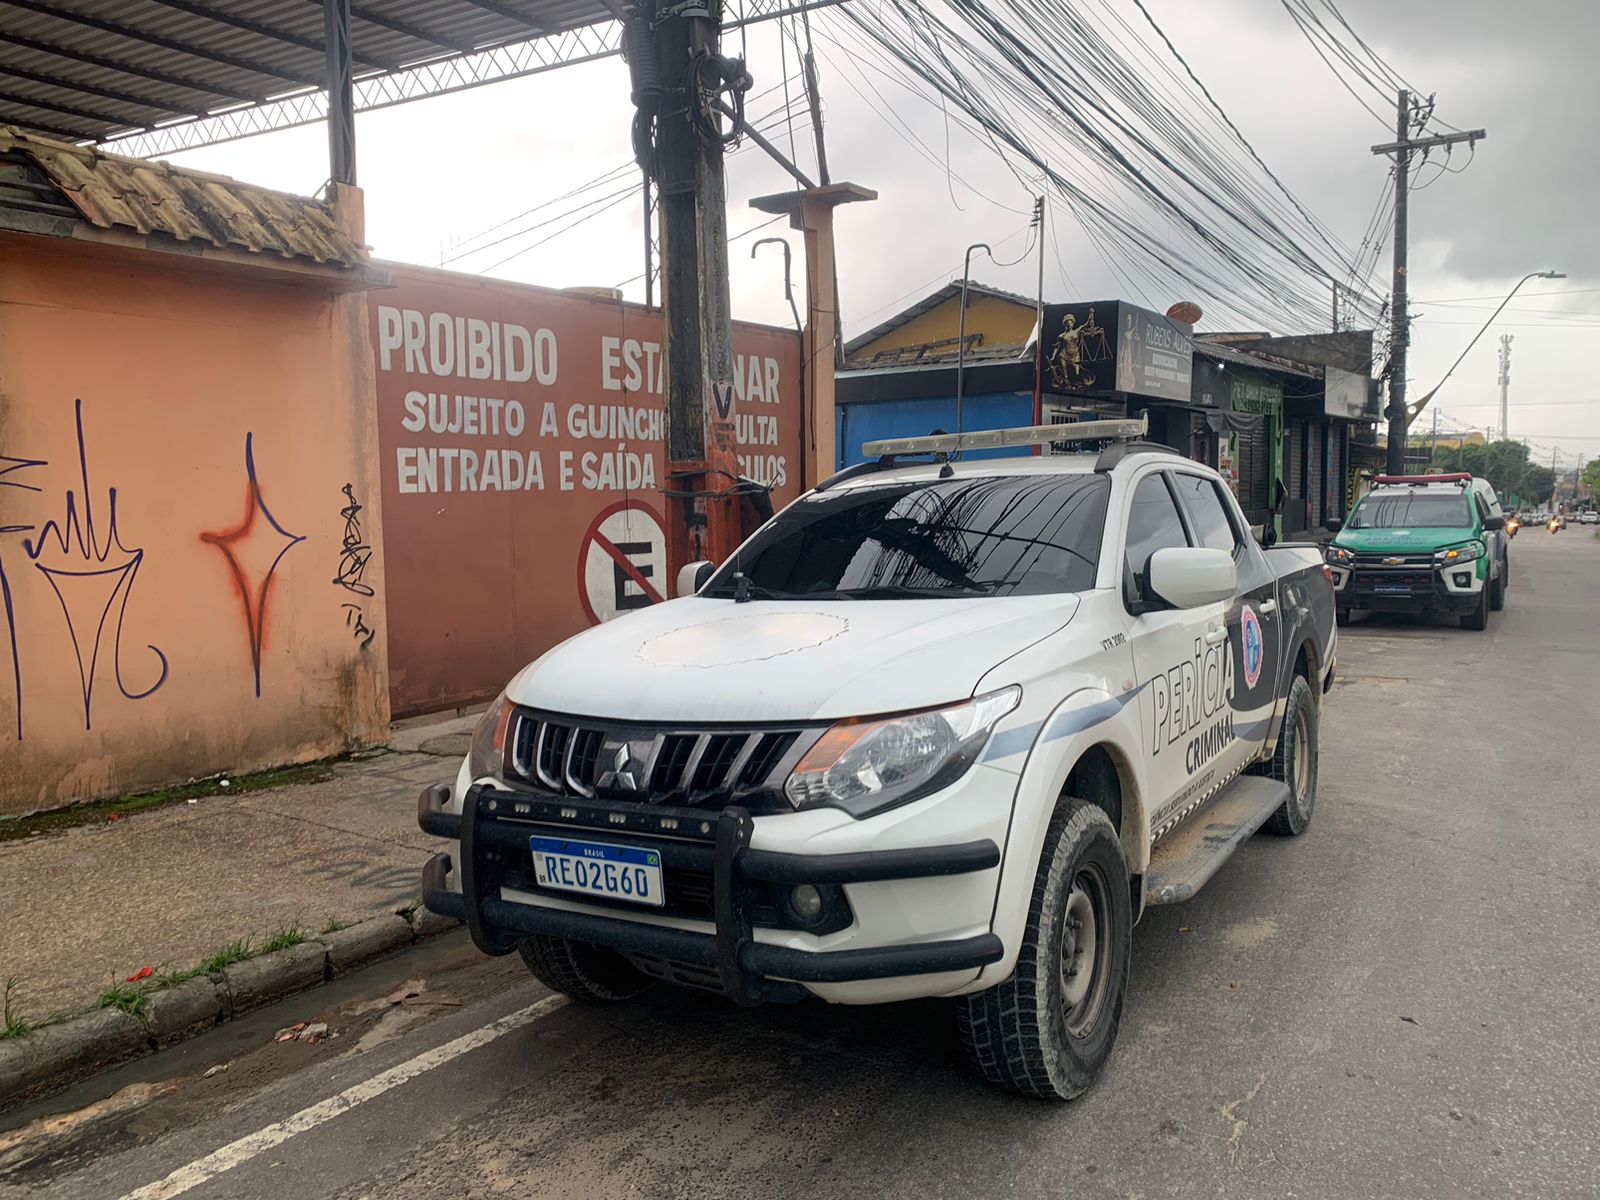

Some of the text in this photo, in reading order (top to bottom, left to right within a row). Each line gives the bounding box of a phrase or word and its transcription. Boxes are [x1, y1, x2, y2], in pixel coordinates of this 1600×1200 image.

[378, 306, 558, 386] PROIBIDO
[402, 391, 525, 437] SUJEITO
[540, 402, 559, 438] A
[735, 415, 778, 446] ULTA
[396, 448, 545, 494] ENTRADA
[560, 453, 574, 491] E
[582, 443, 655, 490] SAÍDA
[1186, 711, 1236, 776] CRIMINAL
[584, 848, 605, 859] BRASIL
